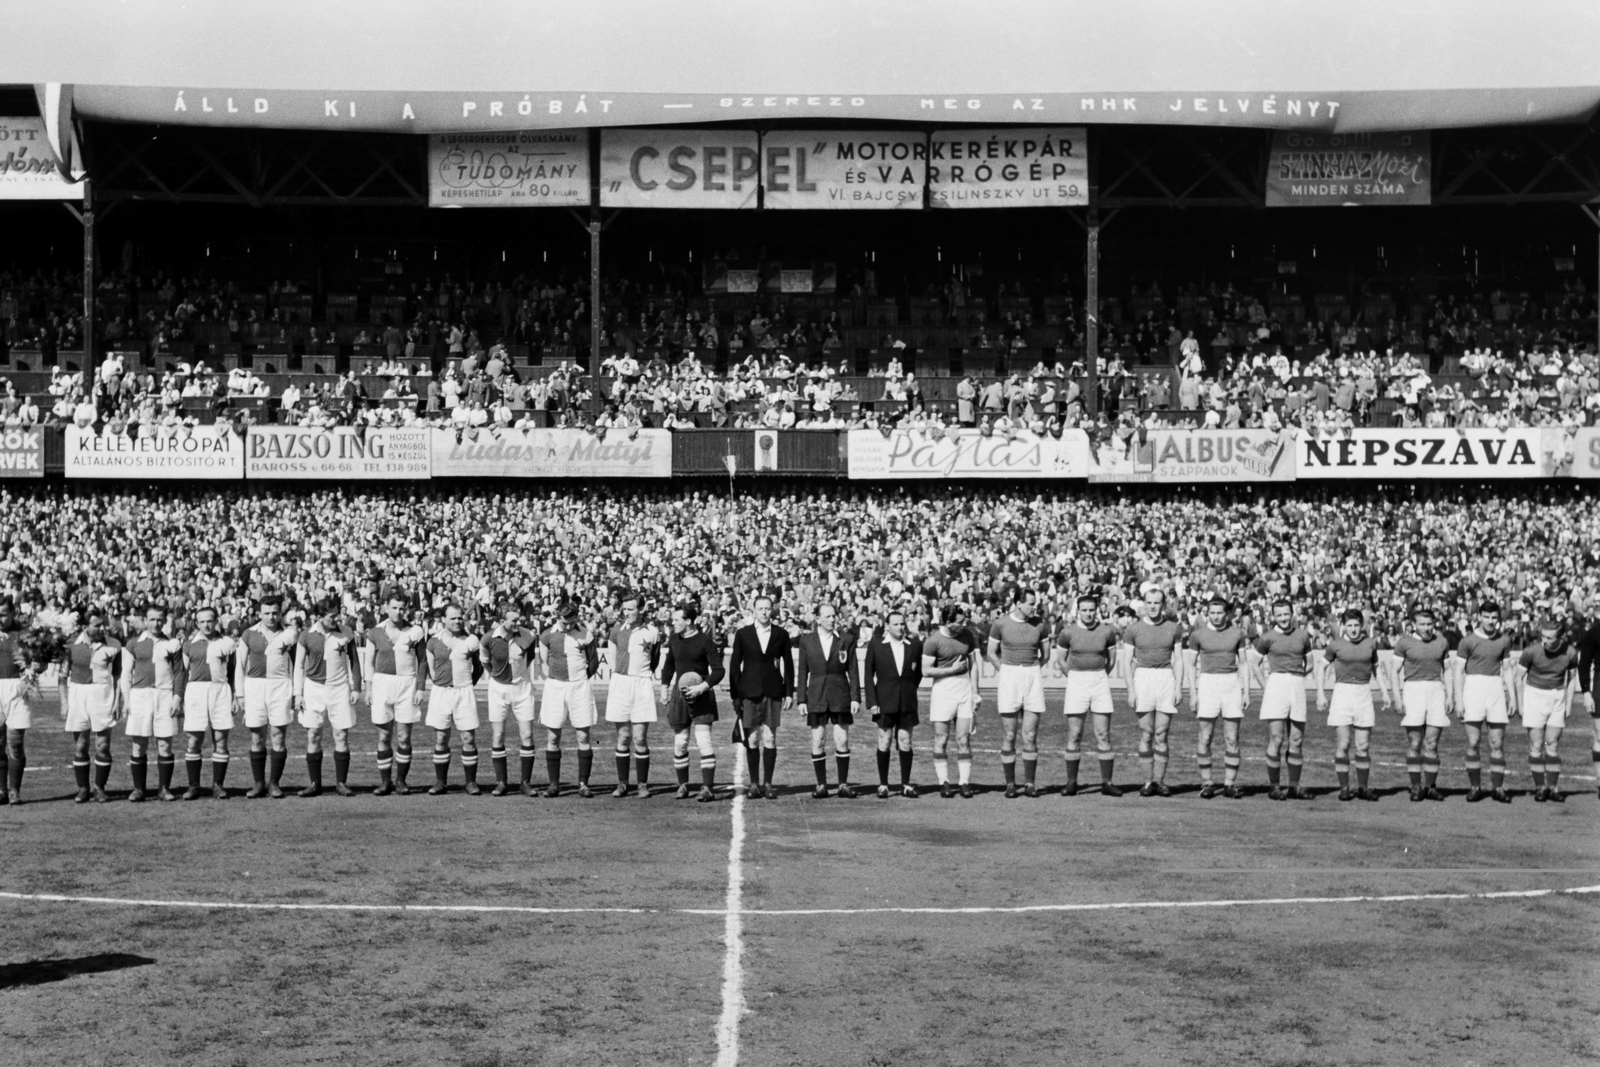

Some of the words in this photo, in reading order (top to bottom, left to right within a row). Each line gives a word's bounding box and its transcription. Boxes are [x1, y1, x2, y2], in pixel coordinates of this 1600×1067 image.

[174, 91, 269, 113] ÁLLD
[325, 100, 356, 117] KI
[402, 103, 415, 119] A
[463, 95, 613, 117] PRÓBÁT
[719, 97, 866, 107] SZEREZD
[920, 98, 982, 109] MEG
[1012, 98, 1045, 110] AZ
[1081, 97, 1137, 110] MHK
[1169, 94, 1340, 119] JELVÉNYT
[507, 146, 519, 154] AZ
[457, 159, 578, 180] TUDOMÁNY
[845, 167, 867, 184] ÉS
[529, 184, 550, 197] 80
[1291, 184, 1349, 197] MINDEN
[389, 433, 426, 441] HOZOTT
[338, 433, 385, 459] ING
[448, 438, 534, 462] Ludas
[567, 438, 653, 465] Matyi
[1159, 434, 1251, 464] ALBUS
[388, 452, 396, 460] IS
[251, 462, 308, 473] BAROSS
[1160, 465, 1238, 478] SZAPPANOK
